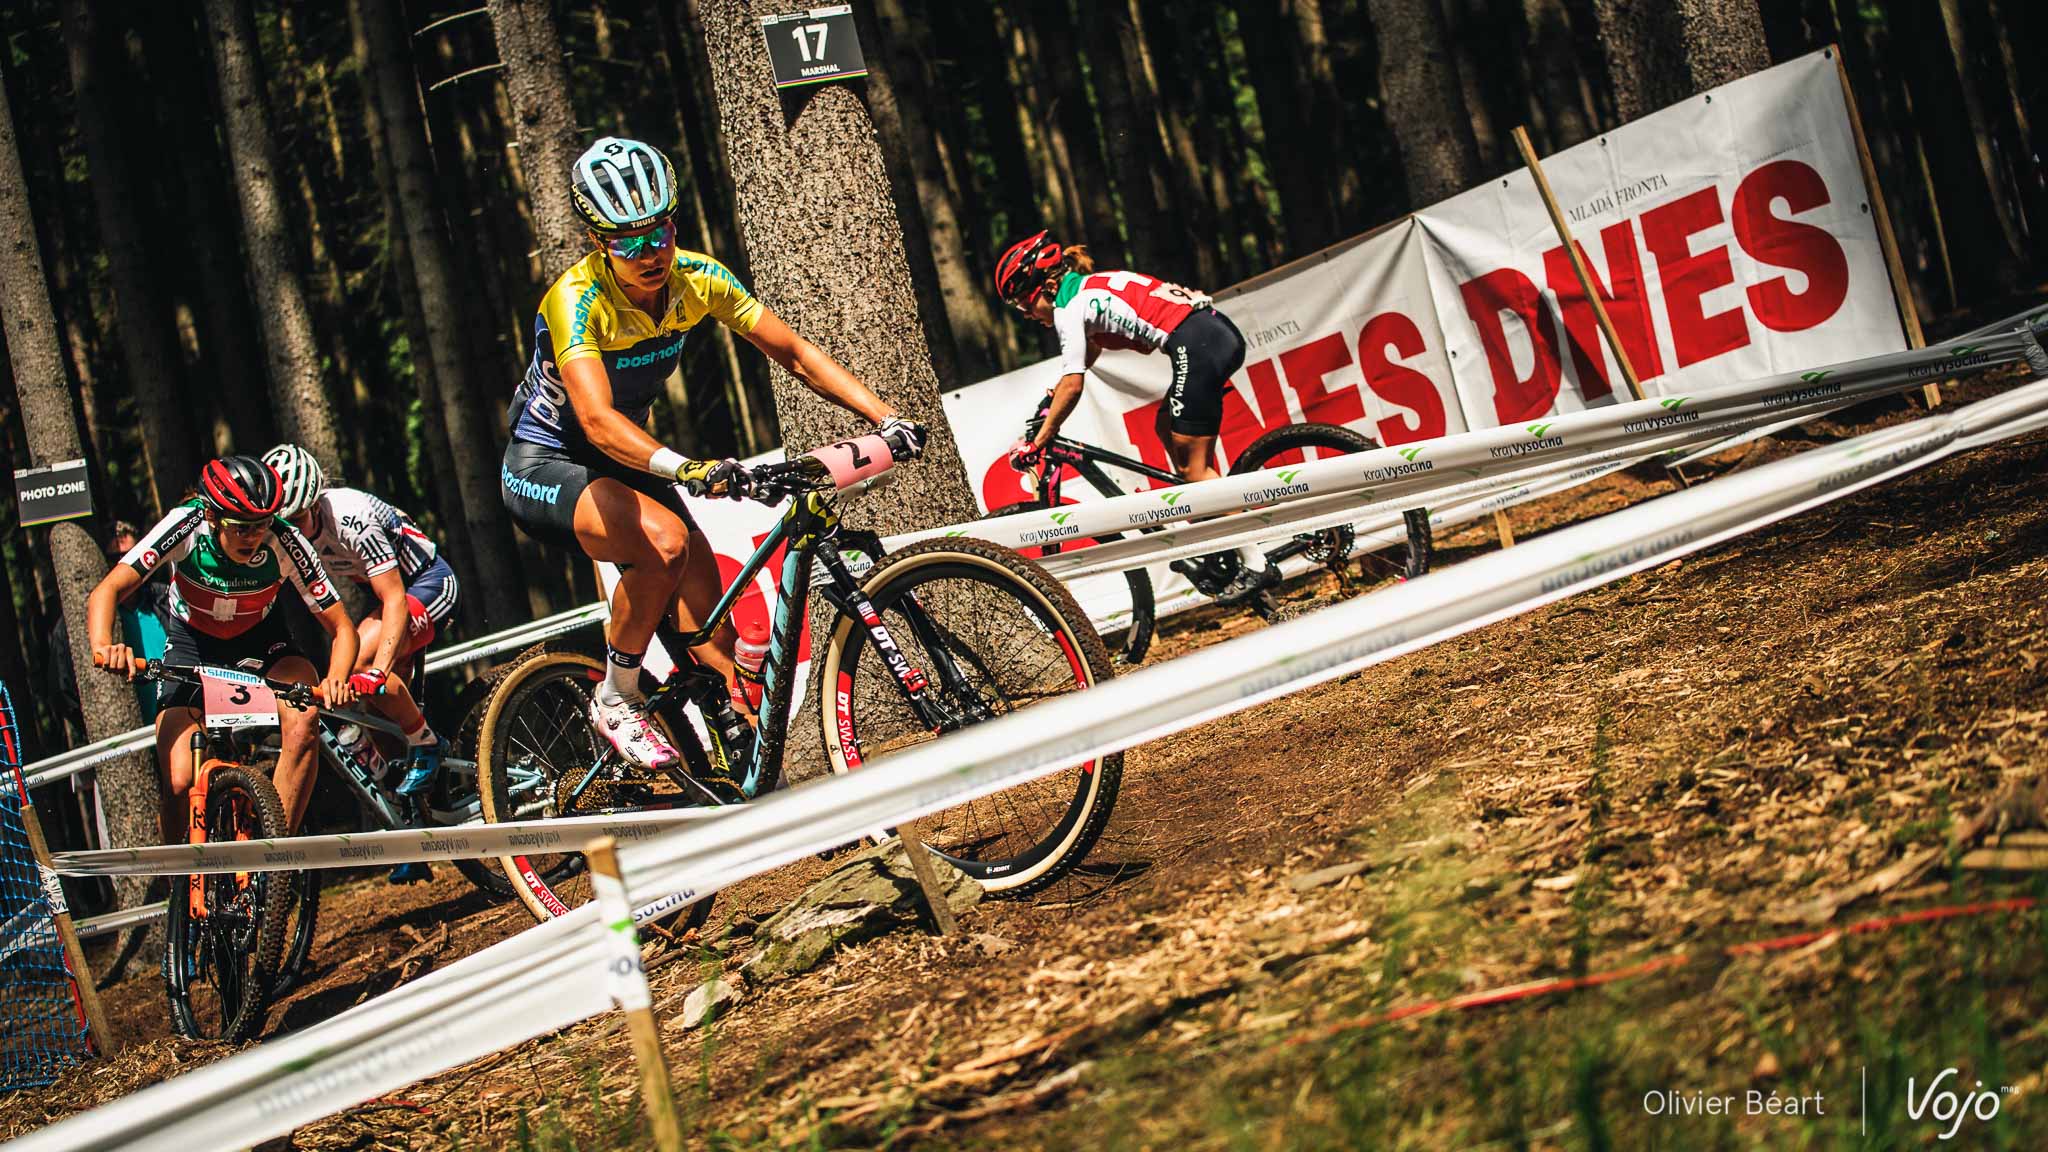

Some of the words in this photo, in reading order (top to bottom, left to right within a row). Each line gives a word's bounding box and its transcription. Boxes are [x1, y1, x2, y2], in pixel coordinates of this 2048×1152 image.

[791, 23, 828, 61] 17
[800, 64, 840, 77] MARSHAL
[1616, 174, 1669, 209] FRONTA
[630, 217, 656, 228] THULE
[1459, 160, 1850, 427] DNES
[1256, 319, 1301, 347] FRONTA
[616, 334, 686, 370] postnord
[833, 442, 872, 470] 2
[20, 486, 56, 502] PHOTO
[56, 481, 86, 496] ZONE
[340, 514, 369, 535] sky
[409, 612, 429, 636] sky
[871, 626, 898, 651] DT
[888, 654, 927, 700] SWS
[228, 683, 251, 705] 3
[837, 690, 849, 716] DT
[523, 871, 541, 890] DT
[537, 888, 572, 917] SWISS
